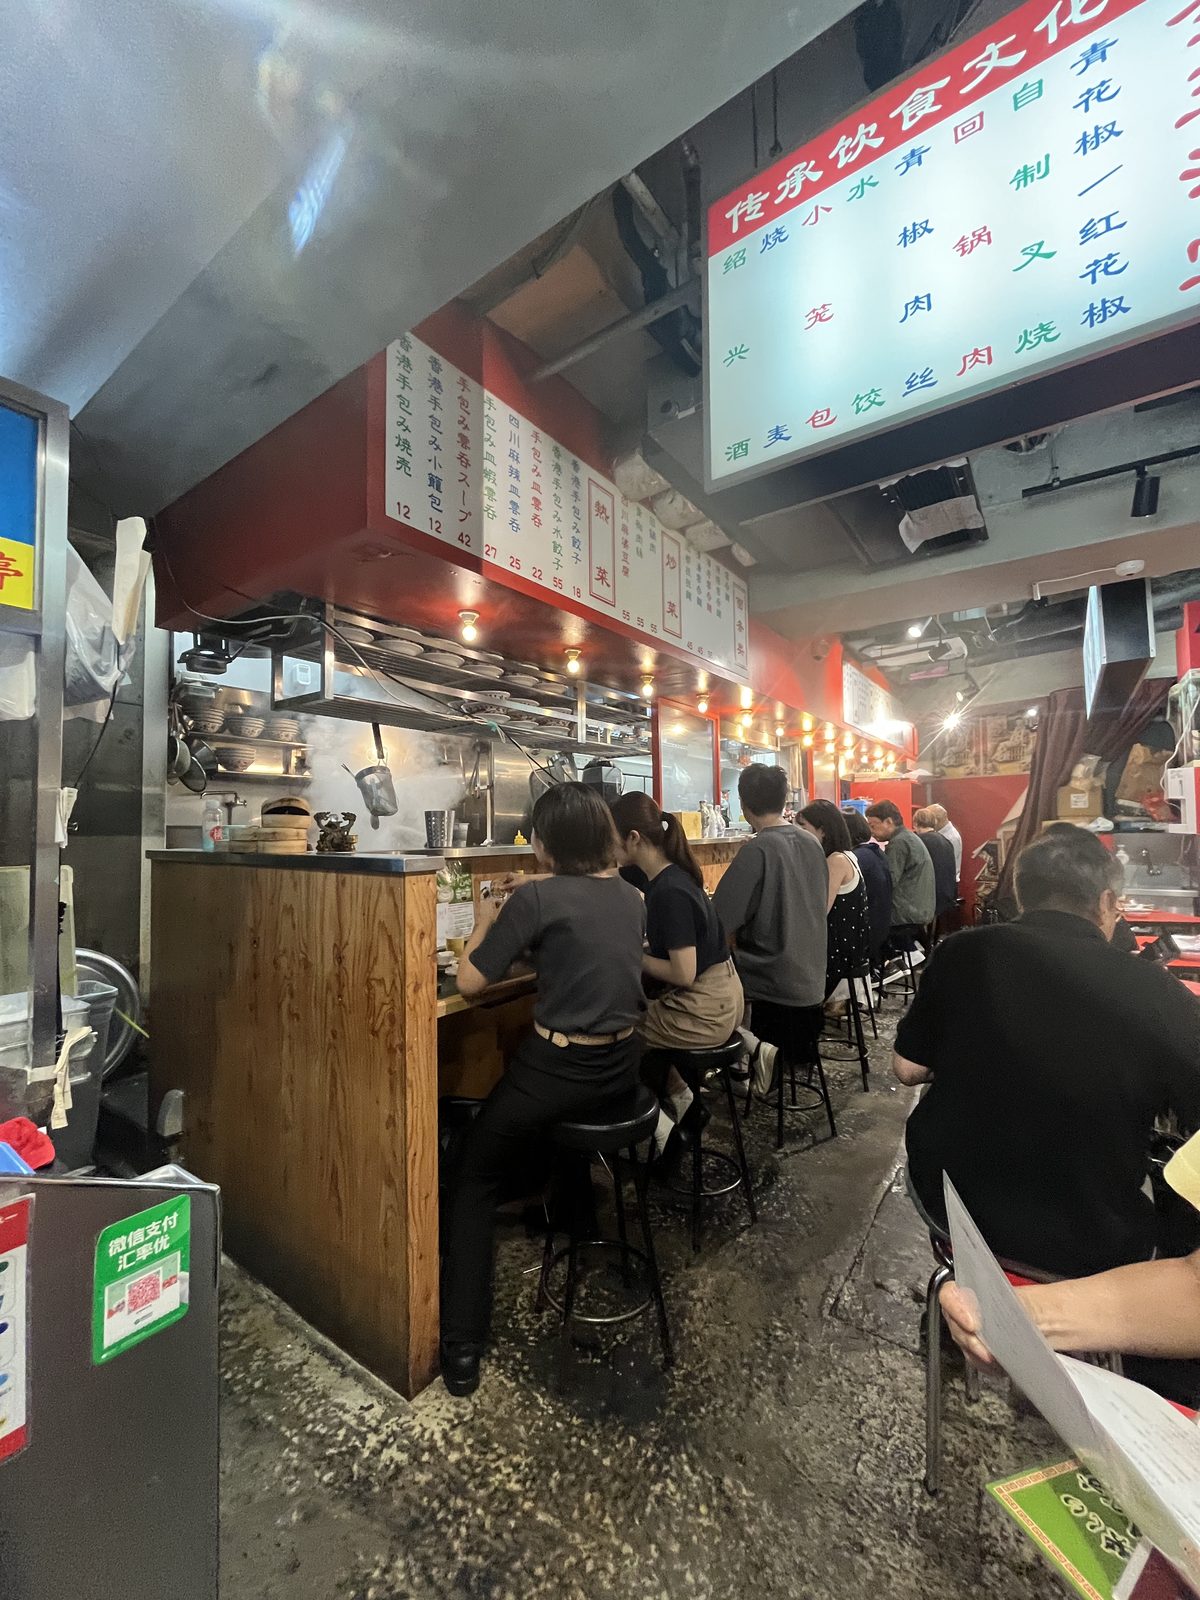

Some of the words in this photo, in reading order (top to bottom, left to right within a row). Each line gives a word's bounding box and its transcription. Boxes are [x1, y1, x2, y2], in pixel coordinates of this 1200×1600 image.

[724, 0, 1108, 233] 传承饮食文化
[953, 111, 995, 377] 回锅肉
[1010, 78, 1062, 355] 自制叉烧
[846, 175, 886, 415] 水饺
[894, 144, 938, 398] 青椒肉丝
[760, 226, 793, 447] 烧麦
[801, 204, 838, 430] 小笼包
[722, 248, 751, 461] 绍兴酒
[396, 501, 411, 520] 12
[428, 517, 442, 534] 12
[457, 531, 472, 548] 42
[484, 543, 497, 560] 27
[509, 555, 521, 571] 25
[532, 566, 543, 581] 22
[594, 500, 611, 588] 熱菜
[552, 576, 563, 590] 55
[572, 585, 582, 599] 18
[109, 1212, 178, 1257] 微信支付
